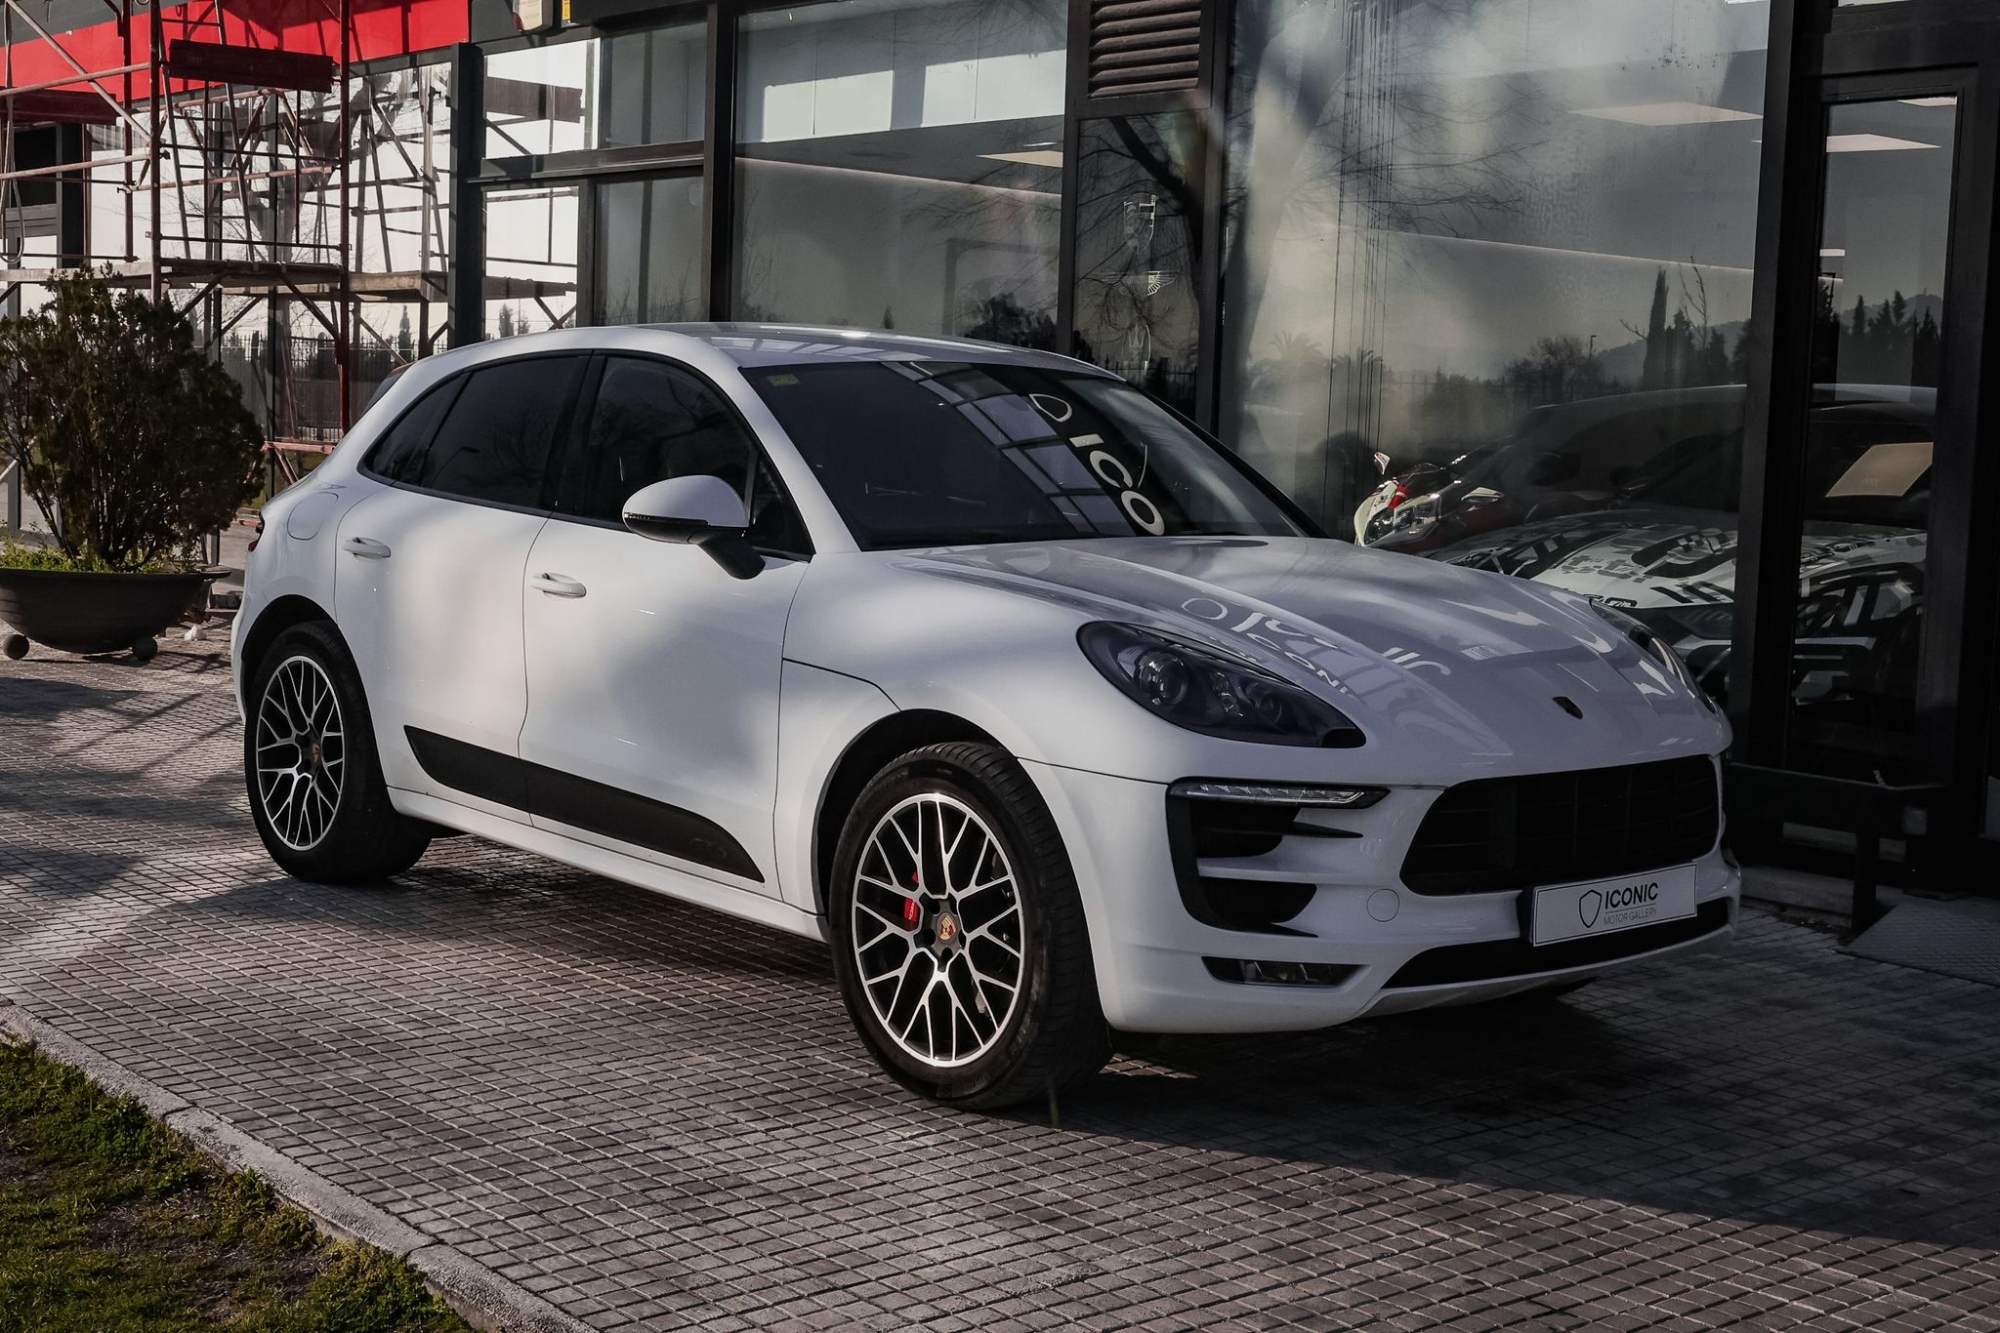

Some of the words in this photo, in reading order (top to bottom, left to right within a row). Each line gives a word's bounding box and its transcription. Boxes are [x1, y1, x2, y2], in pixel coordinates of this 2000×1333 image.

[1605, 882, 1659, 909] ICONIC
[1603, 912, 1628, 925] MOTOR
[1628, 908, 1657, 921] GALLERY
